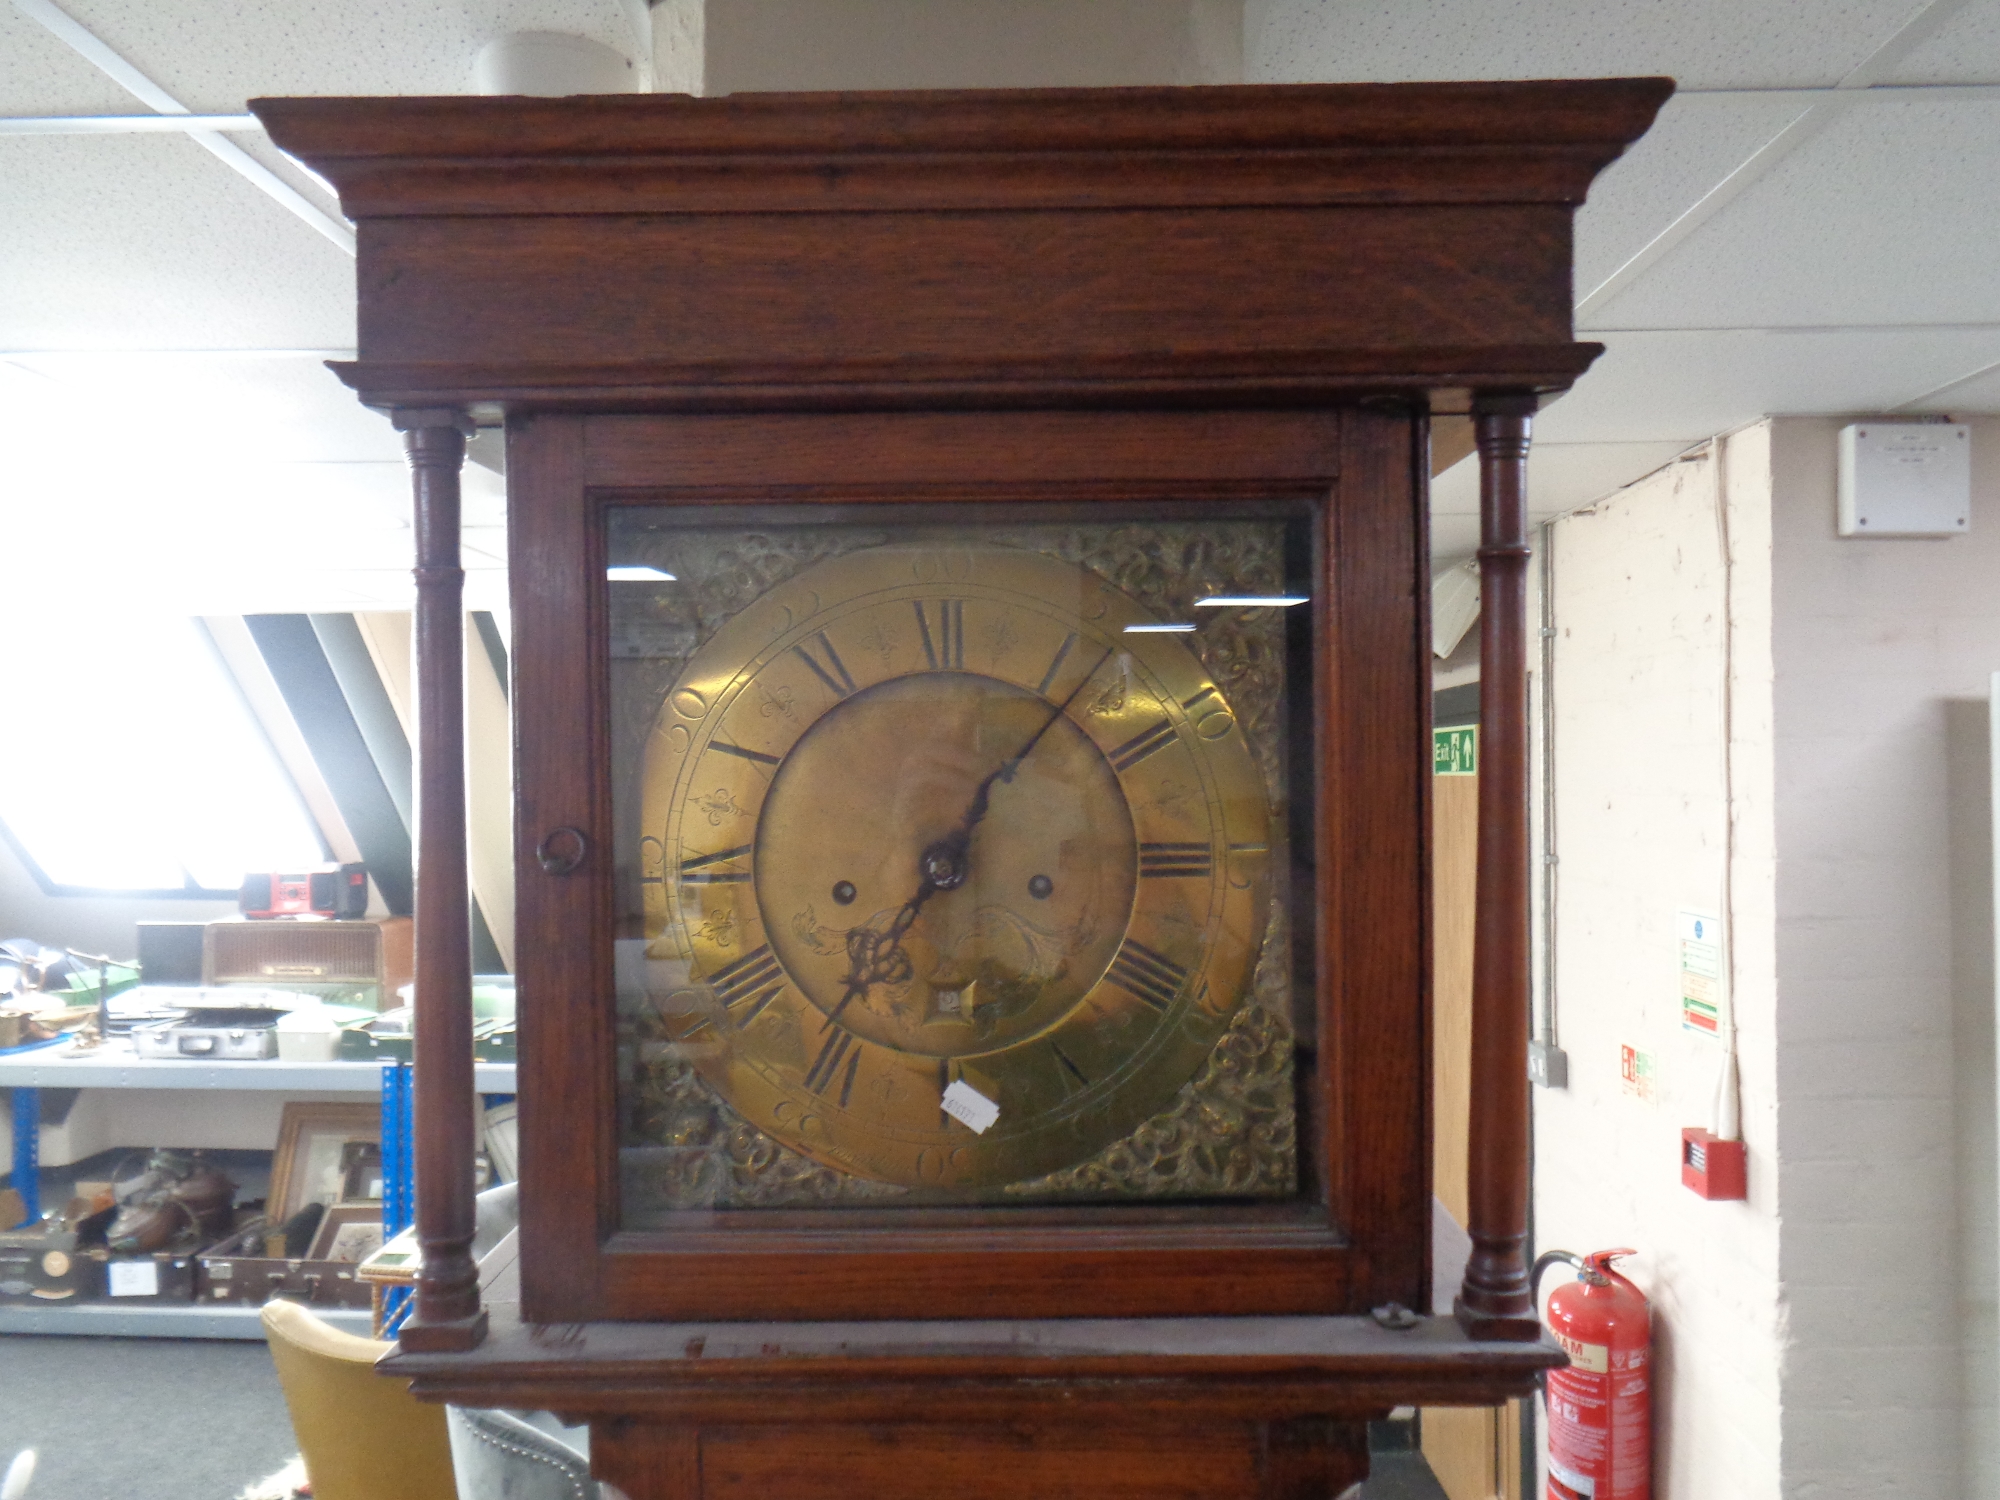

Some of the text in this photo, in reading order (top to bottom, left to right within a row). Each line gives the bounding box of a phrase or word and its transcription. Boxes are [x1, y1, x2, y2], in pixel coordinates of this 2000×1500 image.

[1036, 634, 1078, 694] I
[656, 687, 708, 754] 50
[1183, 687, 1235, 742] 10
[700, 719, 782, 785] X
[1107, 718, 1181, 772] II
[1435, 743, 1449, 761] Exit
[680, 838, 751, 884] IX
[1139, 841, 1211, 879] III
[704, 943, 788, 1031] VIII
[1103, 937, 1189, 1014] IIII
[802, 1025, 862, 1109] VII
